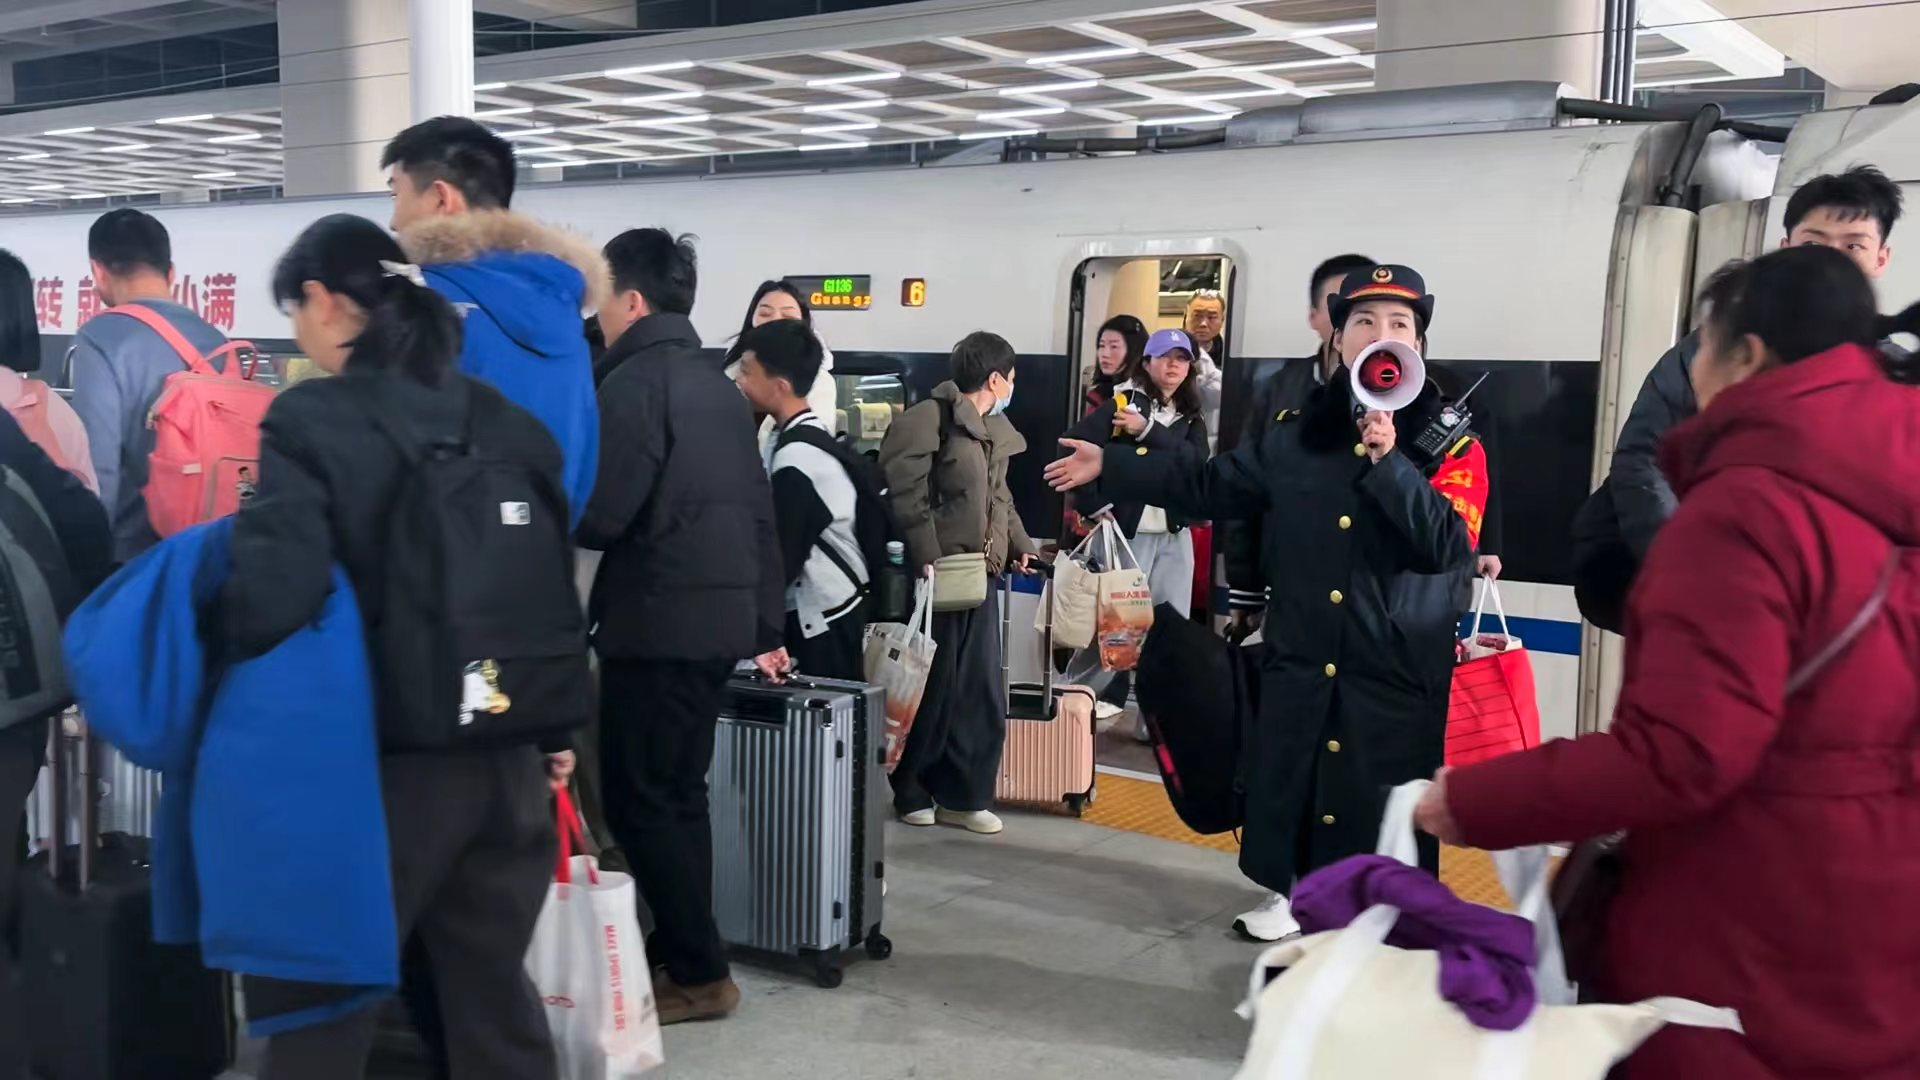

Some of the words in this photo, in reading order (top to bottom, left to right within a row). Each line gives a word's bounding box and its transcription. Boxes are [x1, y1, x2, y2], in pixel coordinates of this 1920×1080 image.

[824, 279, 853, 293] G1136
[909, 281, 925, 305] 6
[604, 924, 617, 949] MAKE
